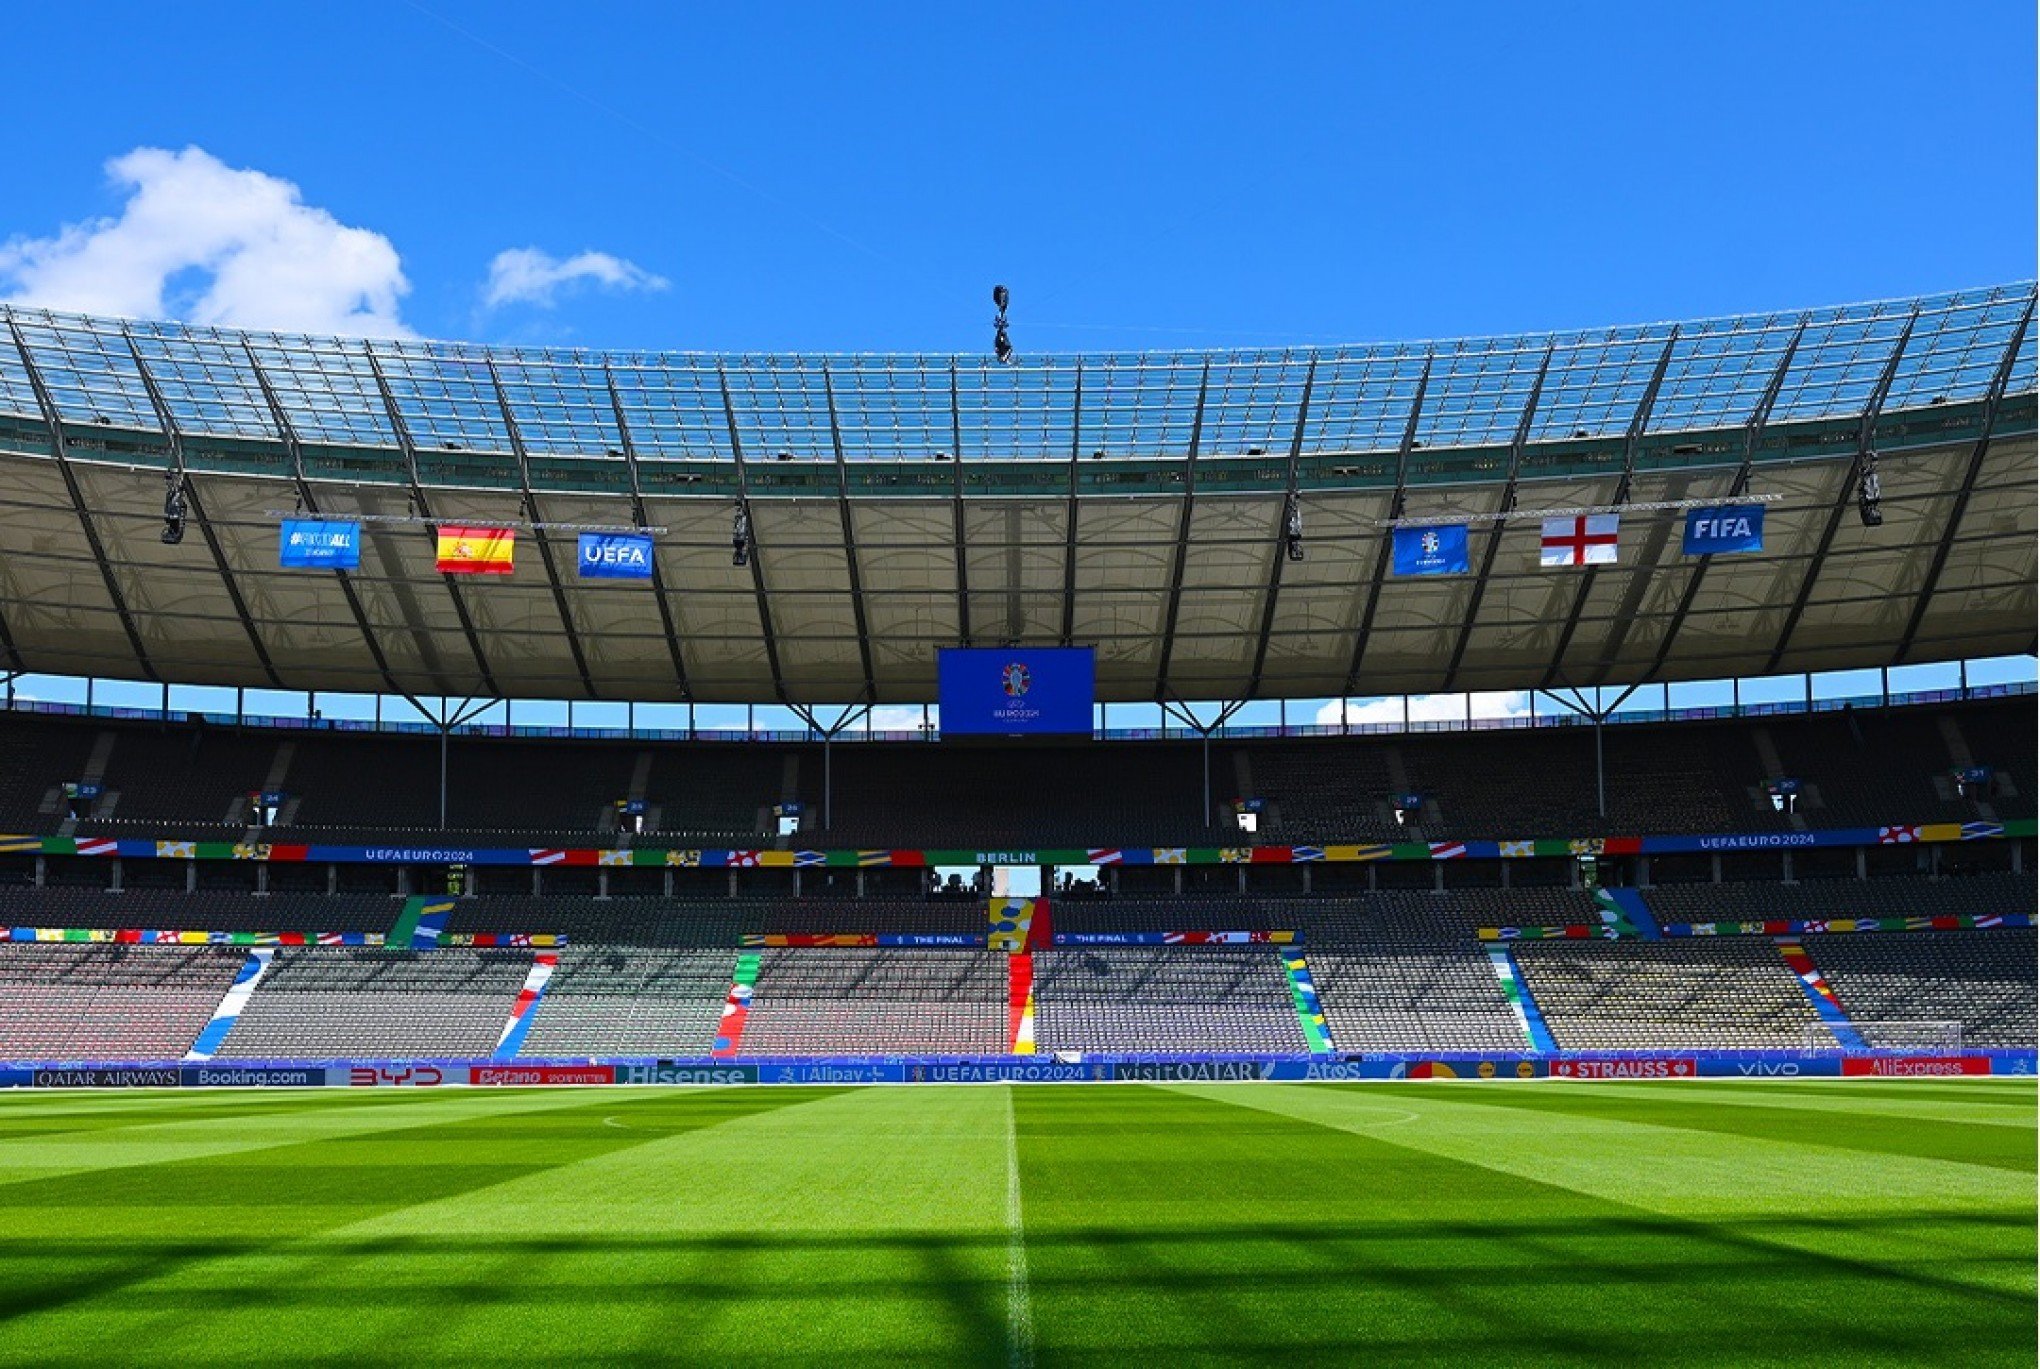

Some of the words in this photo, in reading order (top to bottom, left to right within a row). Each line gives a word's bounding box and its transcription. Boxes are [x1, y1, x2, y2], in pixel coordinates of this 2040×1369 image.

[1694, 517, 1752, 539] FIFA
[585, 546, 645, 564] UEFA
[976, 853, 1036, 864] BERLIN
[628, 1066, 746, 1084] Hisense
[1577, 1061, 1669, 1078] STRAUSS
[1737, 1060, 1799, 1076] vivo
[1870, 1058, 1964, 1076] AliExpress
[38, 1071, 96, 1087] QATAR
[104, 1071, 176, 1085] AIRWAYS
[199, 1070, 307, 1087] Booking.com
[350, 1068, 443, 1086] BYD
[479, 1070, 541, 1084] Betano
